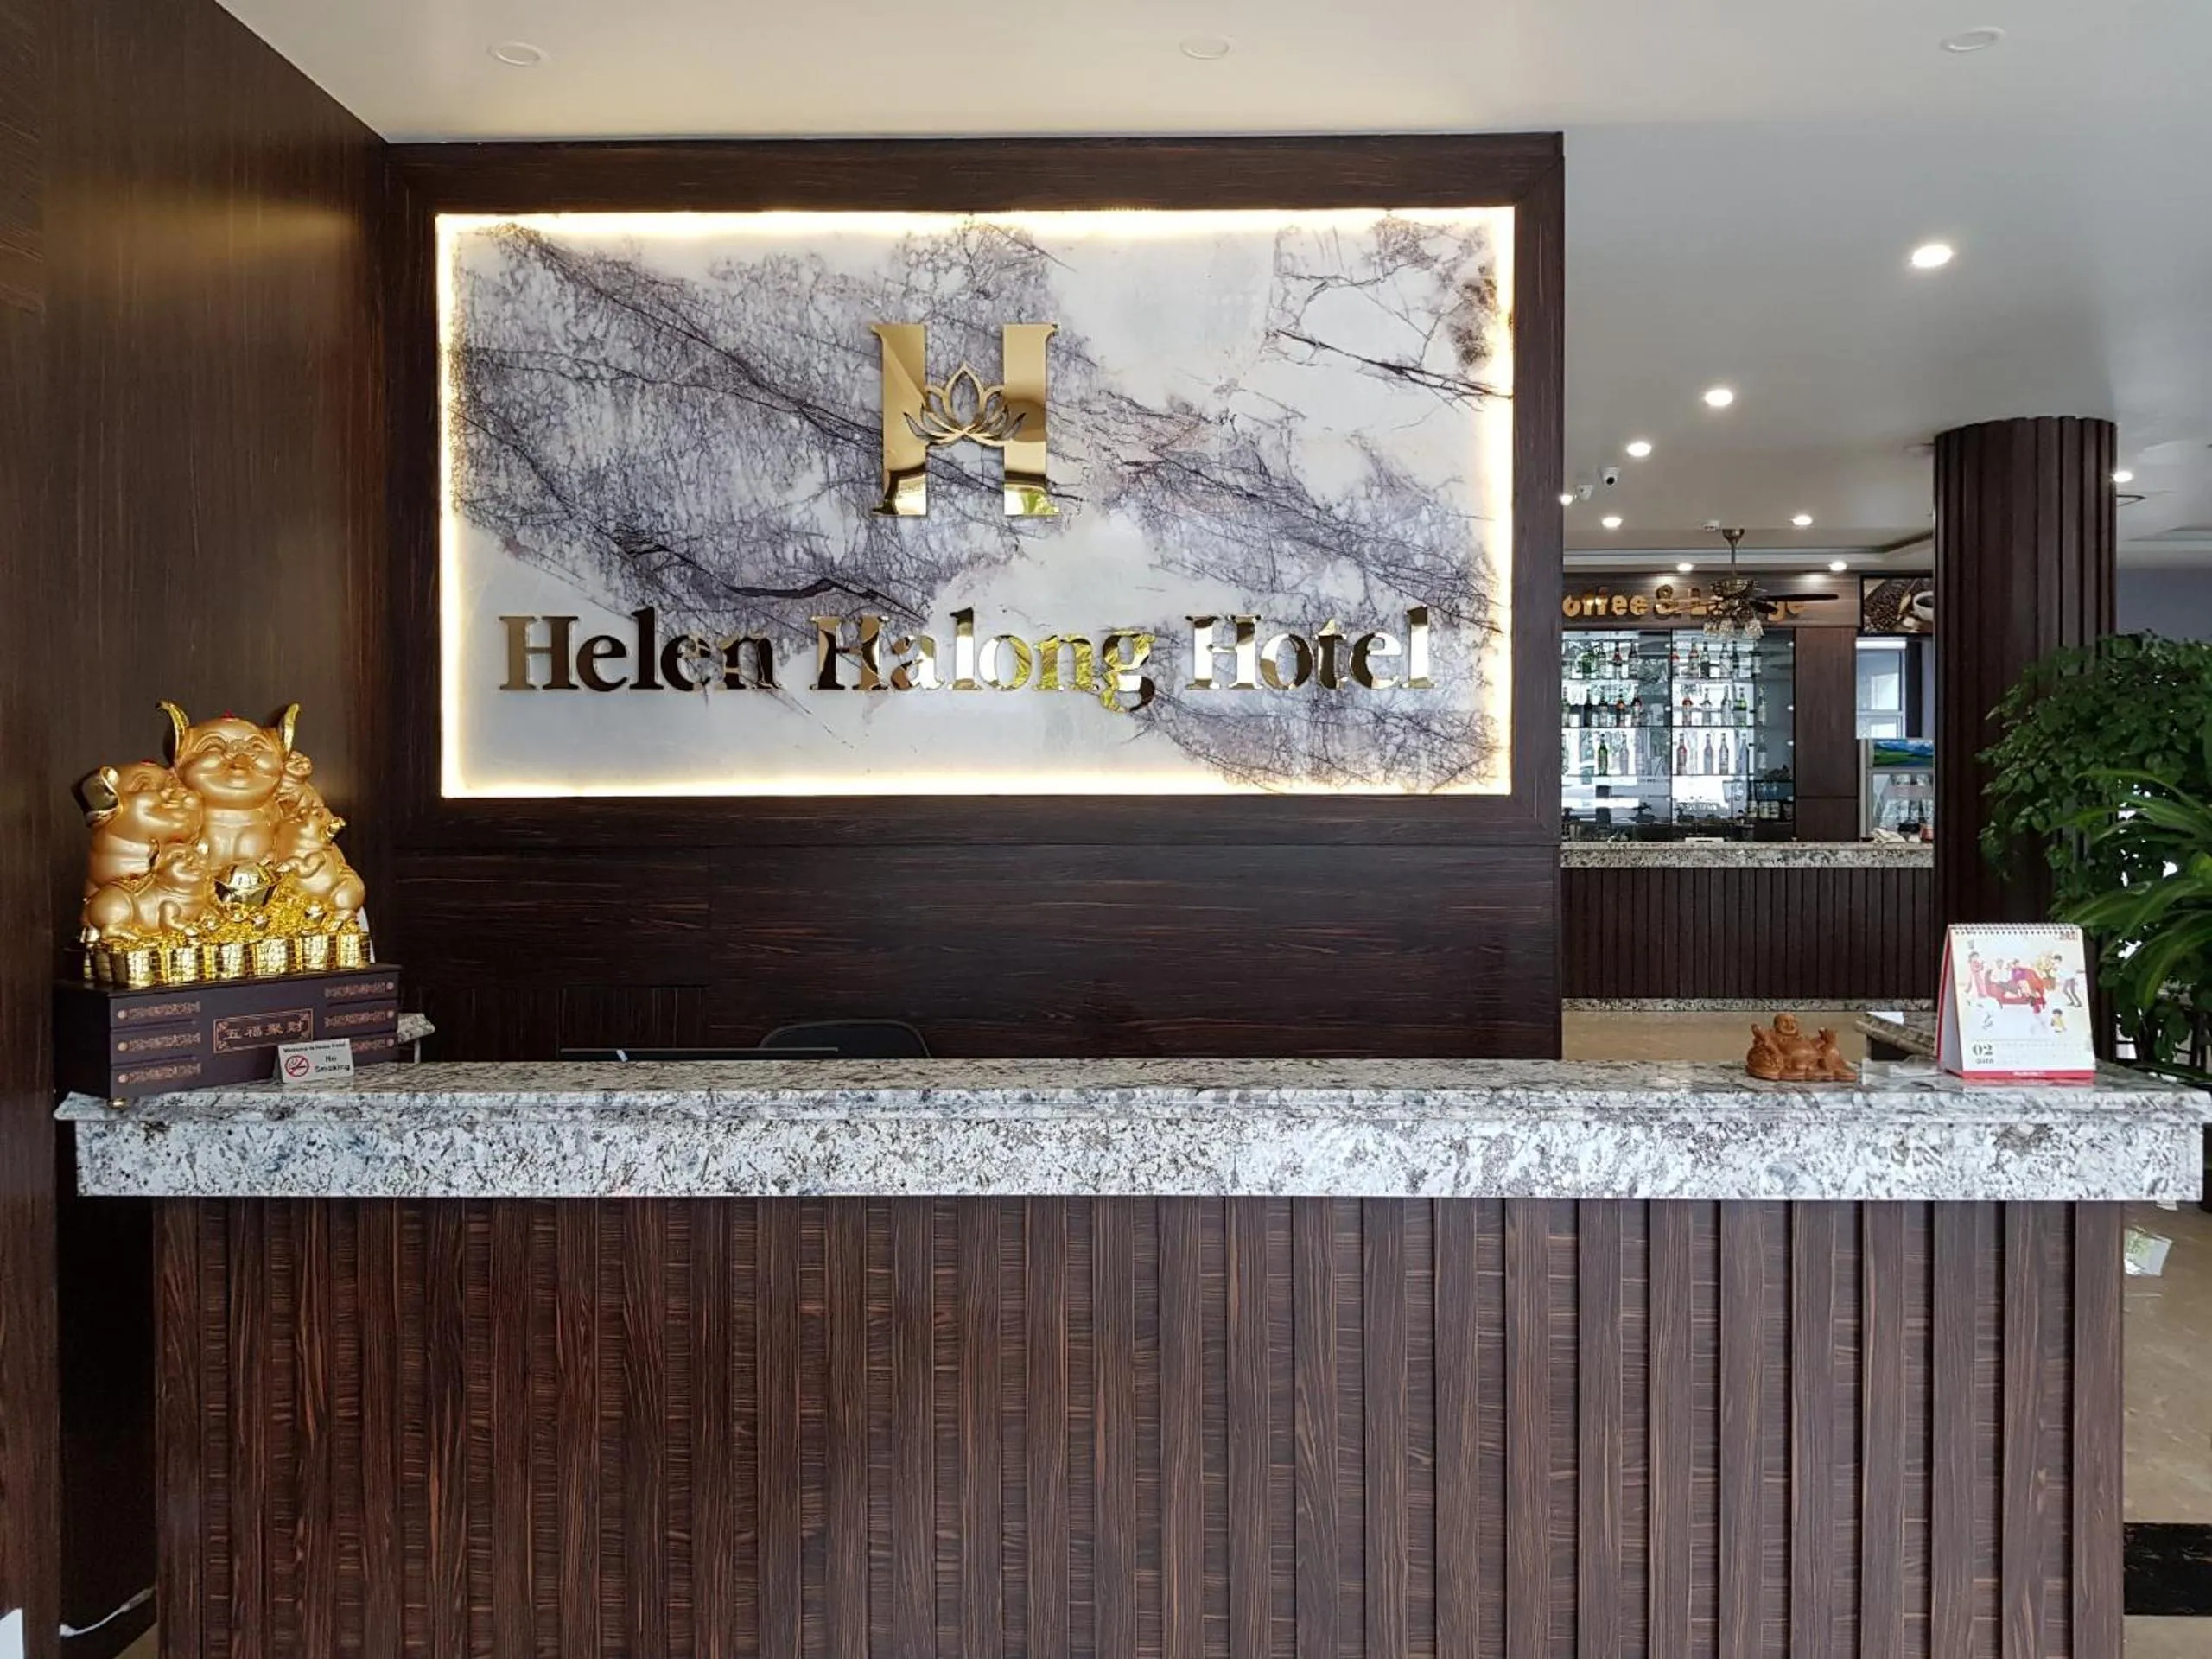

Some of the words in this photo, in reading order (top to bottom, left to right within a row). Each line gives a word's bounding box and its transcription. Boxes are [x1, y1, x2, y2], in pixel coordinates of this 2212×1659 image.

[871, 323, 1059, 516] H
[1562, 586, 1649, 617] offee
[499, 606, 778, 691] Helen
[810, 606, 1155, 714] Halong
[1185, 605, 1440, 690] Hotel
[1972, 1043, 1993, 1056] 02
[315, 1064, 351, 1072] Smoking
